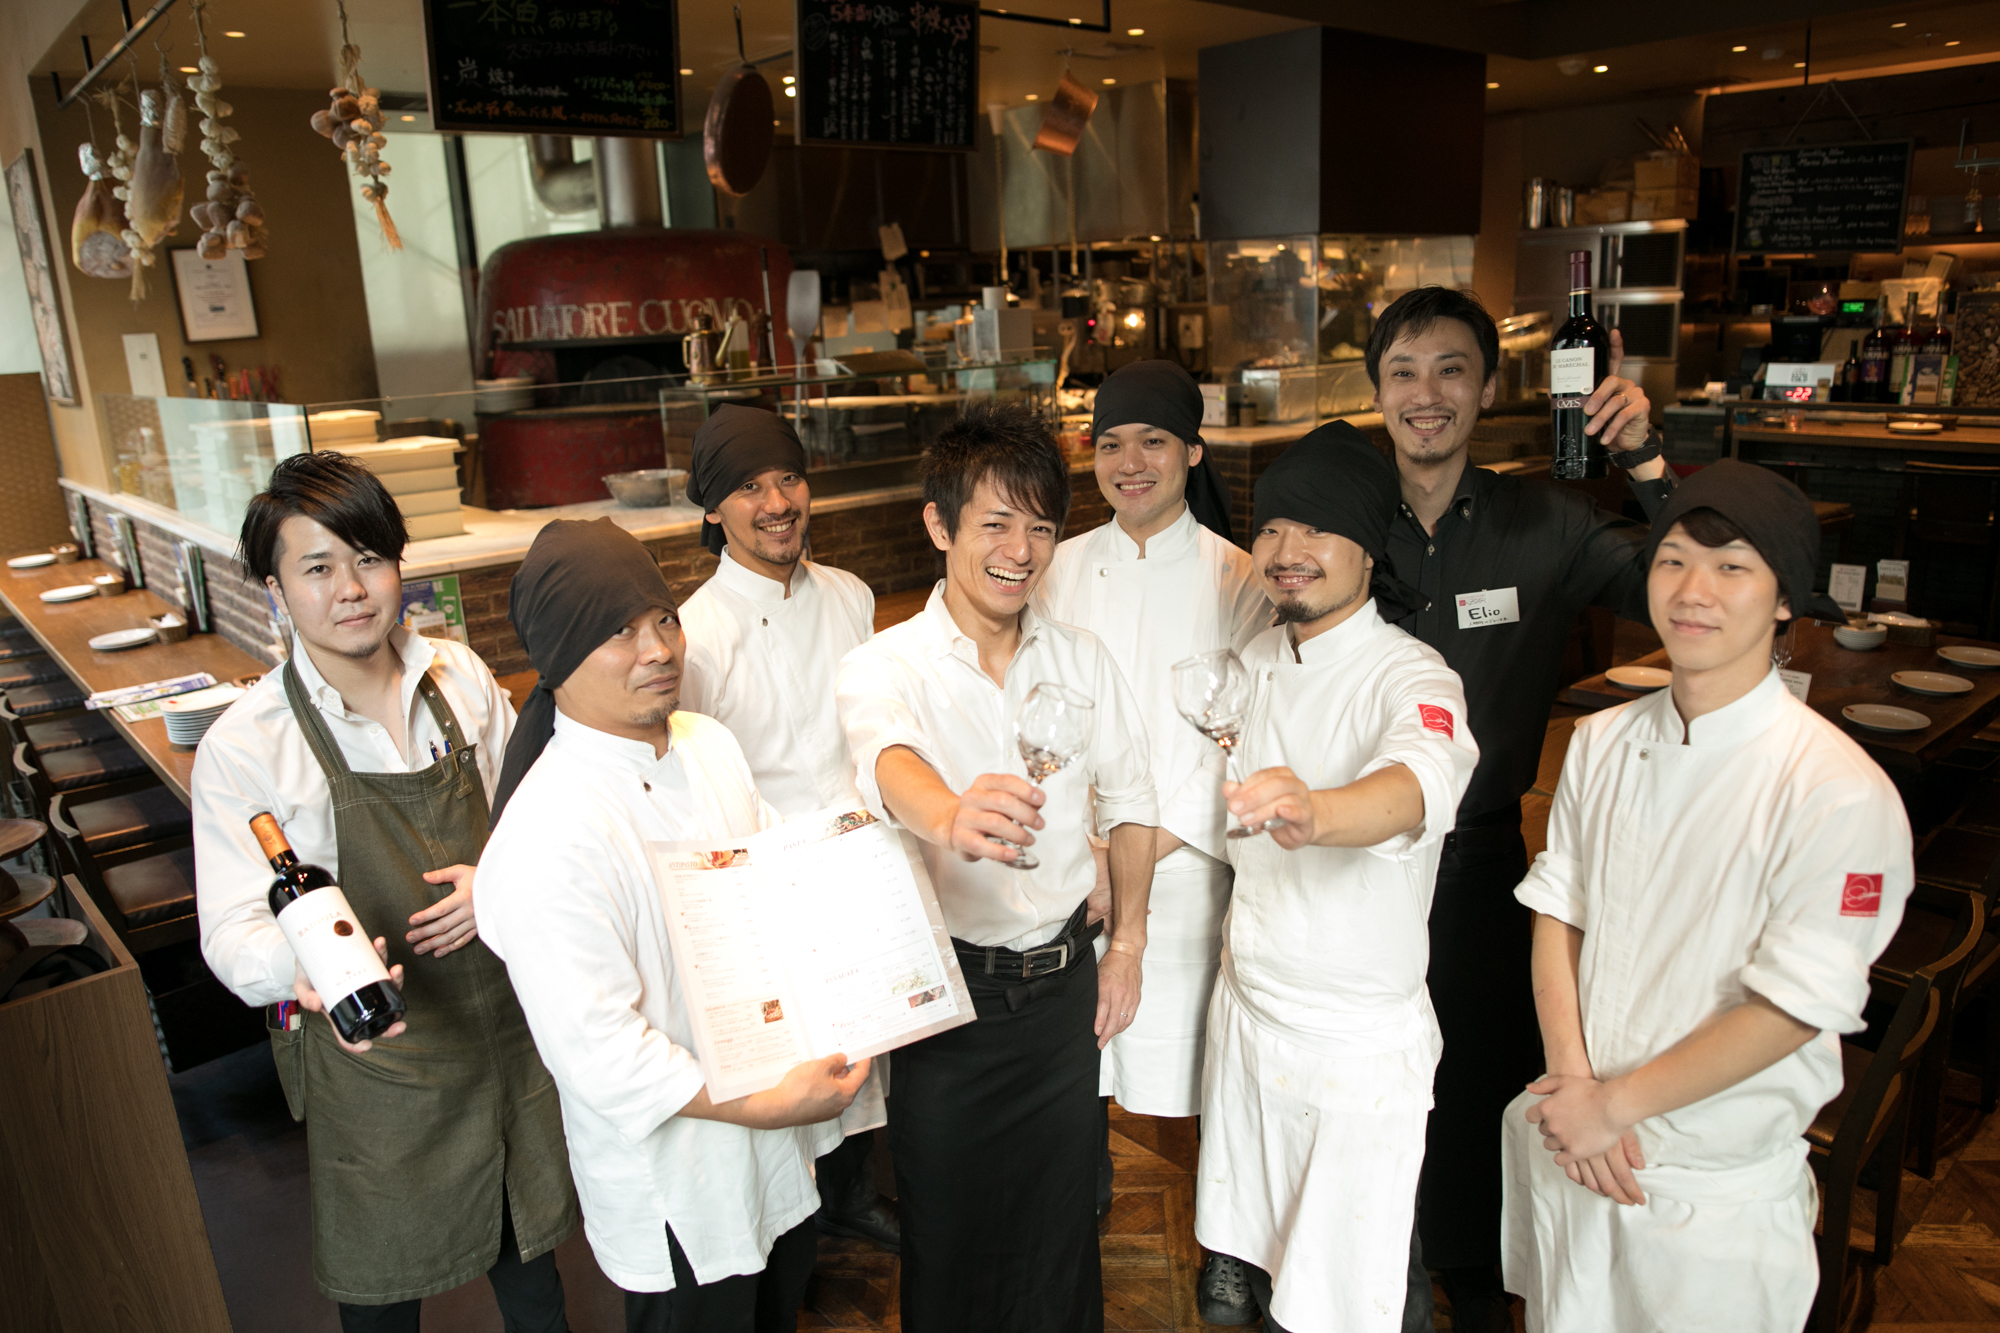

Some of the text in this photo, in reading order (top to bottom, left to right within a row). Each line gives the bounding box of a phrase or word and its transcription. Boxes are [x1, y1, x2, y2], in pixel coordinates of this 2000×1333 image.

[493, 301, 633, 343] SALVATORE
[1556, 398, 1581, 408] CAZES
[1468, 606, 1501, 620] Elio
[297, 911, 343, 938] BADIOLA
